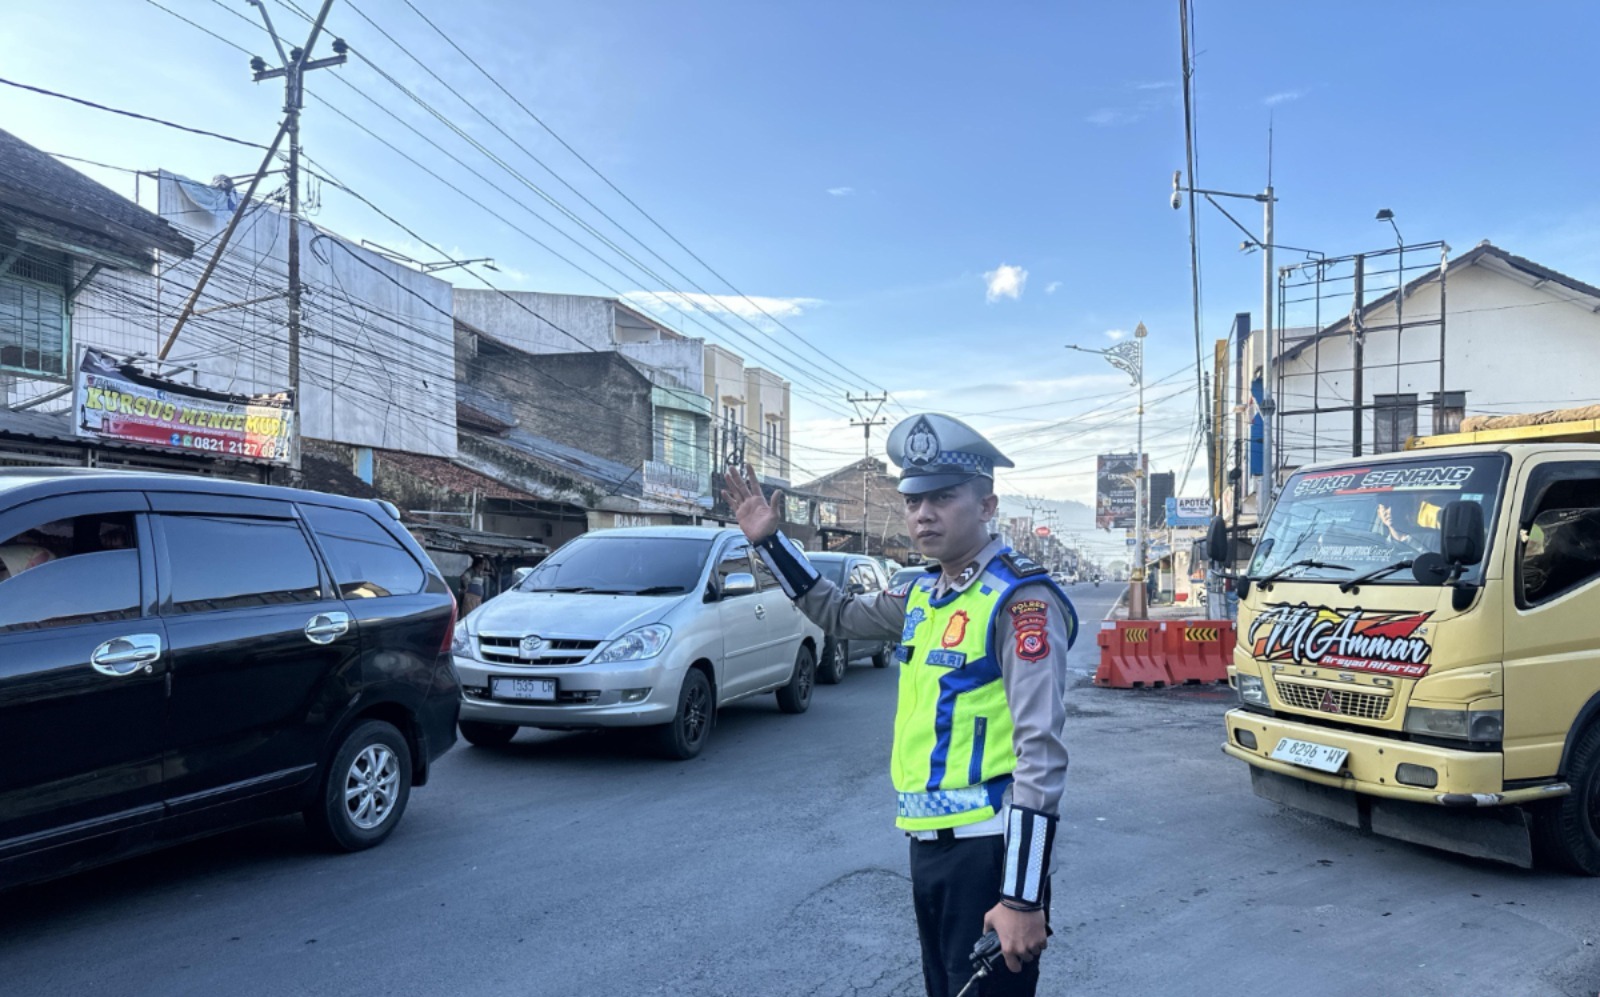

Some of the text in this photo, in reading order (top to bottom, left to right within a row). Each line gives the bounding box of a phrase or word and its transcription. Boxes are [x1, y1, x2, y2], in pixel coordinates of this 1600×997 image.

[86, 387, 177, 422] KURSUS
[179, 407, 287, 438] MENGEMUDI
[194, 437, 225, 452] 0821
[229, 441, 258, 456] 2127
[1294, 473, 1355, 491] SUKA
[1361, 466, 1474, 486] SENANG
[1179, 498, 1211, 507] APOTEK
[1011, 601, 1046, 613] POLRES
[1321, 655, 1369, 669] Arsyad
[512, 679, 534, 692] 1535
[542, 681, 554, 692] CR
[1276, 739, 1287, 752] D
[1289, 742, 1318, 758] 8296
